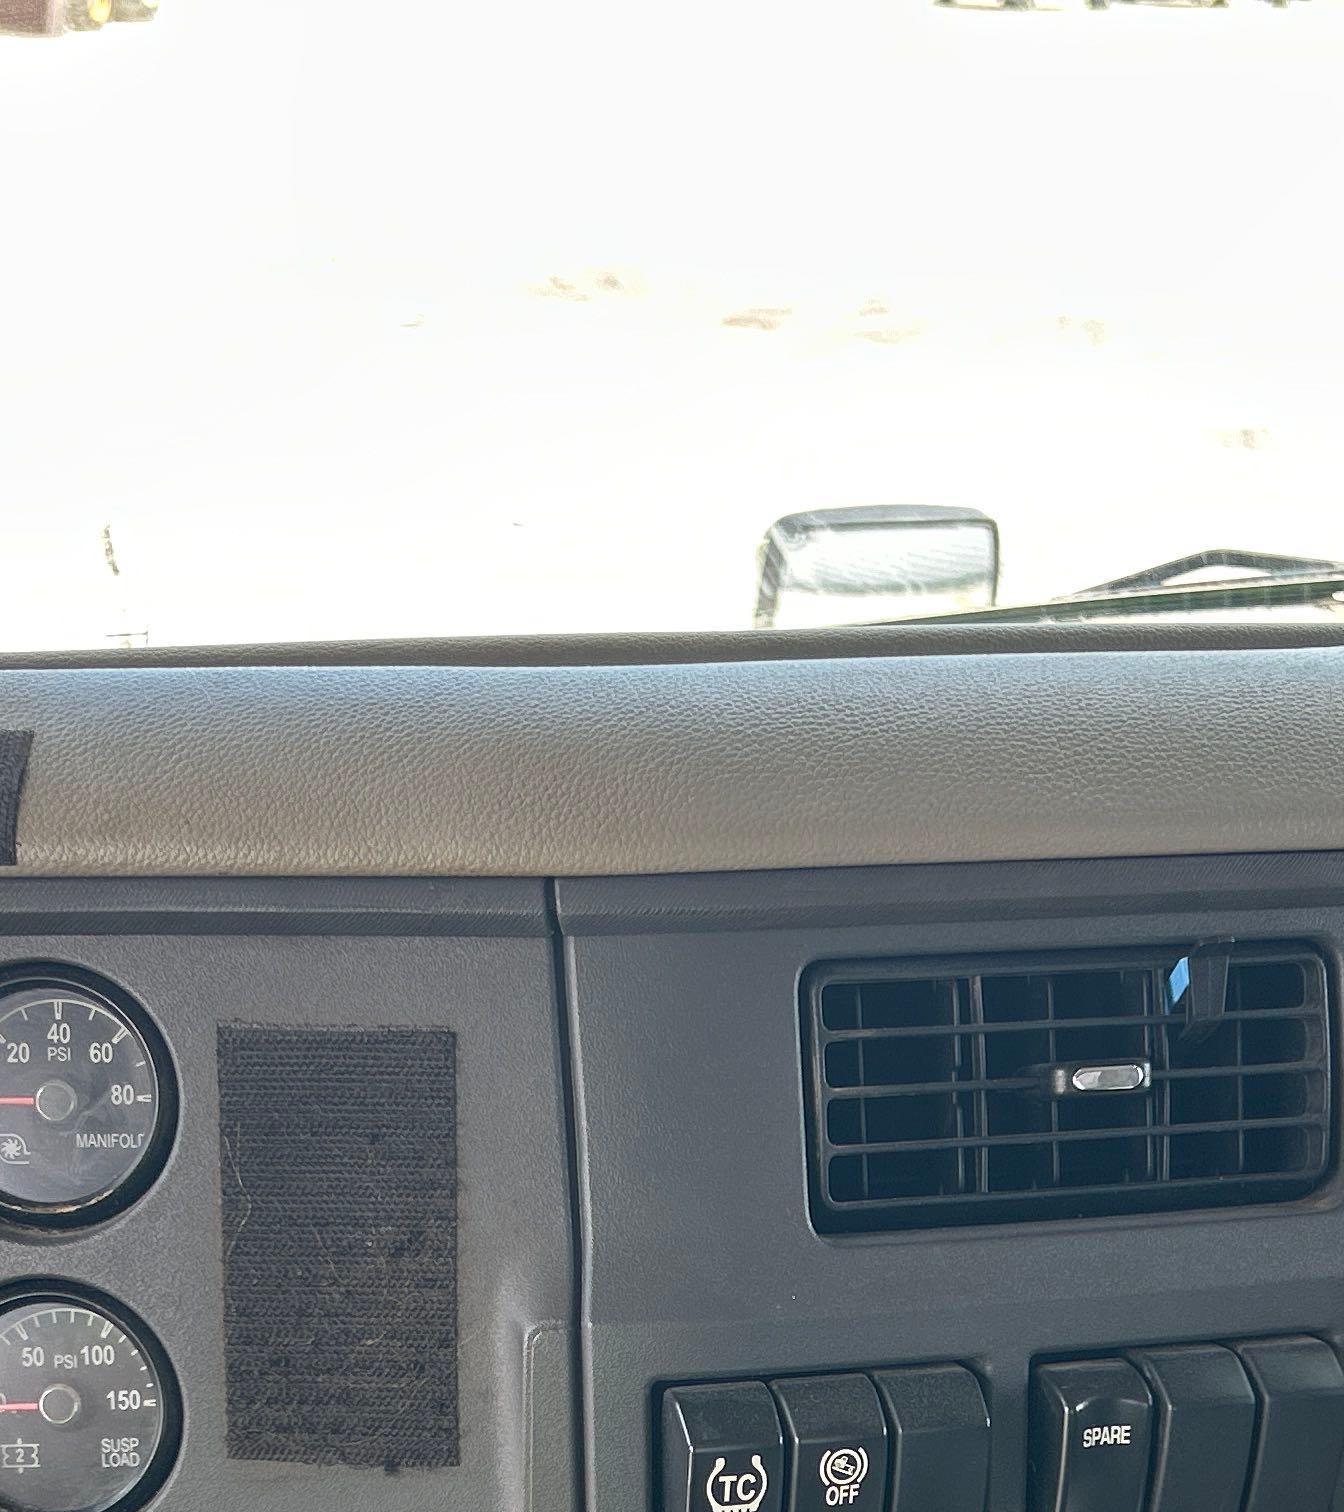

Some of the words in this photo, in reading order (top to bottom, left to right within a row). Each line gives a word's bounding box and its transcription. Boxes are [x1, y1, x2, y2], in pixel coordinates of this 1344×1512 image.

[47, 1022, 71, 1044] 40
[6, 1042, 30, 1064] 20
[47, 1047, 71, 1062] PSI
[89, 1042, 113, 1064] 60
[111, 1084, 134, 1105] 80
[22, 1346, 45, 1367] 50
[54, 1354, 78, 1369] PSI
[80, 1345, 115, 1366] 100
[107, 1389, 141, 1410] 150
[101, 1437, 139, 1453] SUSP
[1082, 1425, 1131, 1448] SPARE
[15, 1449, 26, 1463] 2
[101, 1453, 140, 1468] LOAD
[718, 1473, 757, 1503] TC
[825, 1483, 861, 1507] OFF
